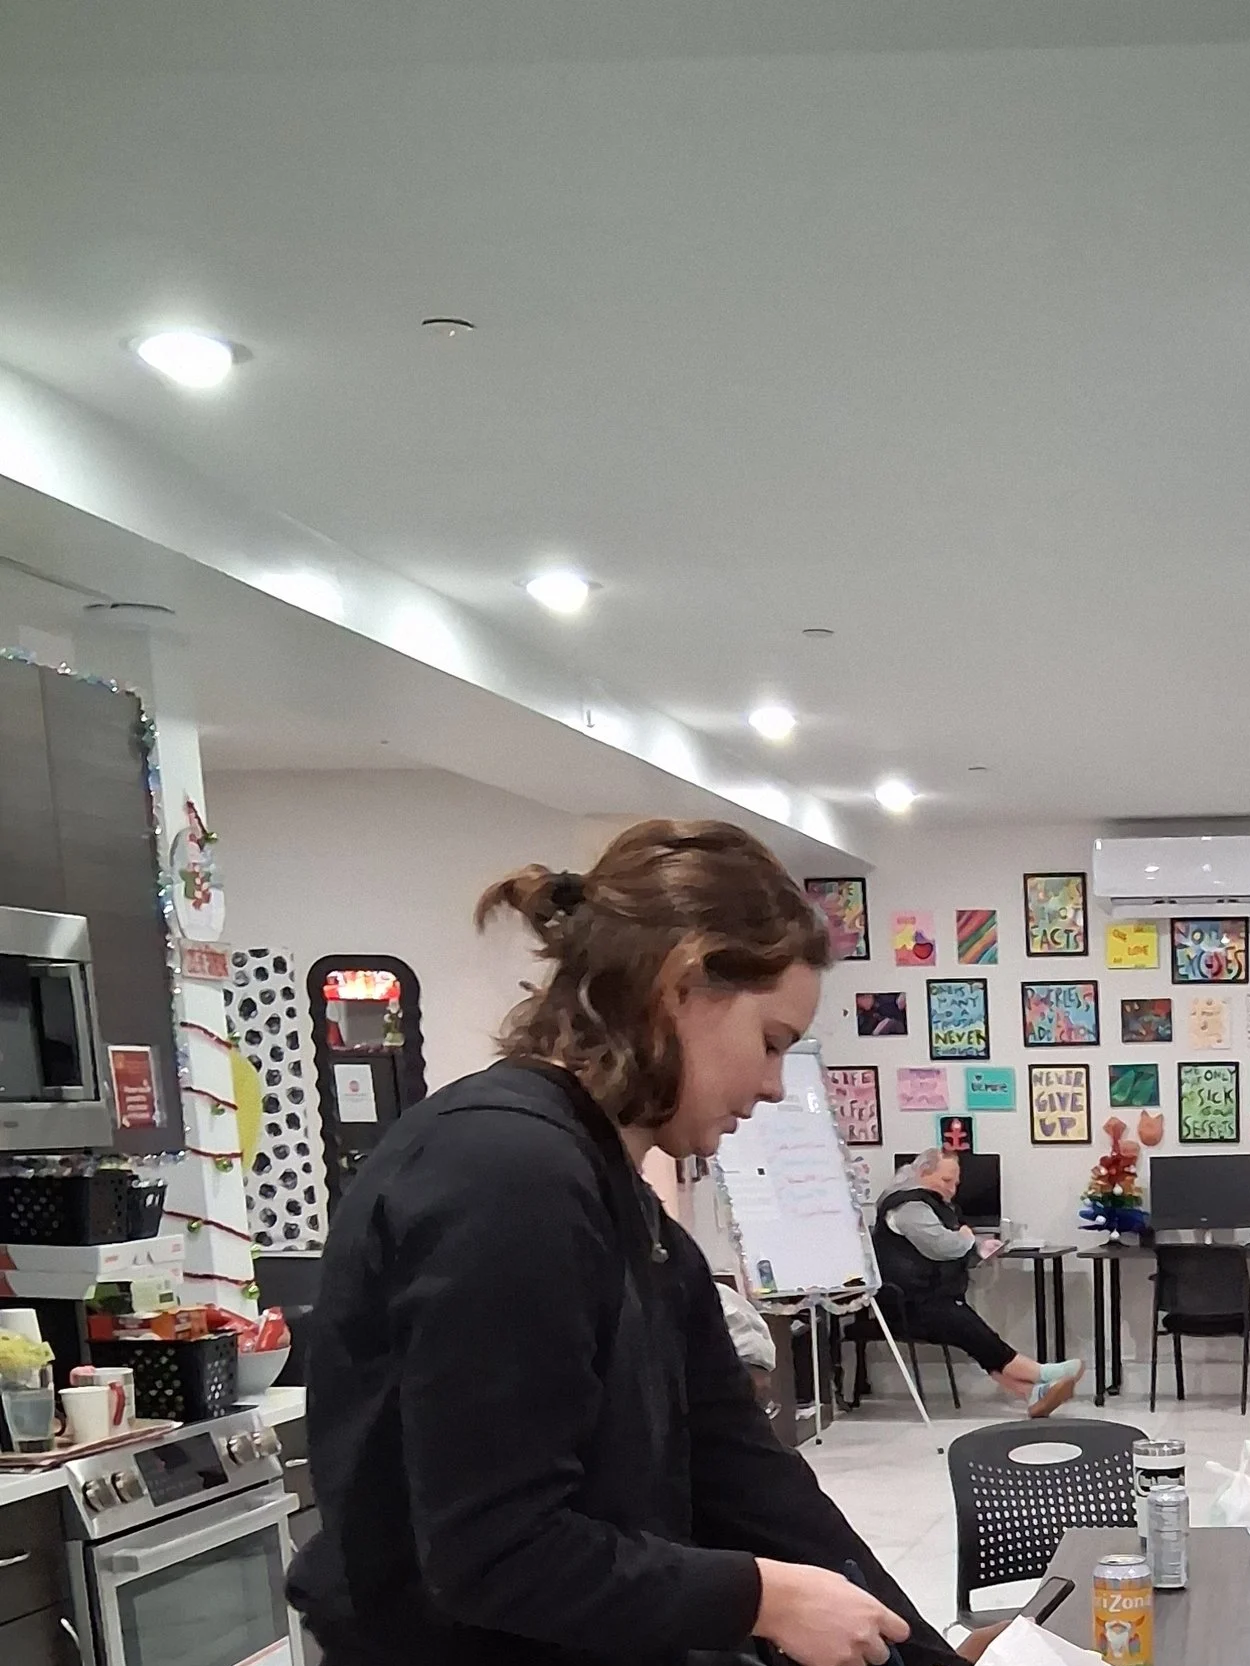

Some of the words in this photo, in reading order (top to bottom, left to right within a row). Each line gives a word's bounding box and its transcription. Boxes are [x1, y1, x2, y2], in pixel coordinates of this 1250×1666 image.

[934, 1030, 986, 1045] NEVER
[1033, 1070, 1084, 1088] NEVER
[1035, 1091, 1084, 1112] GIVE
[1197, 1087, 1234, 1107] SICK
[1039, 1116, 1077, 1137] UP
